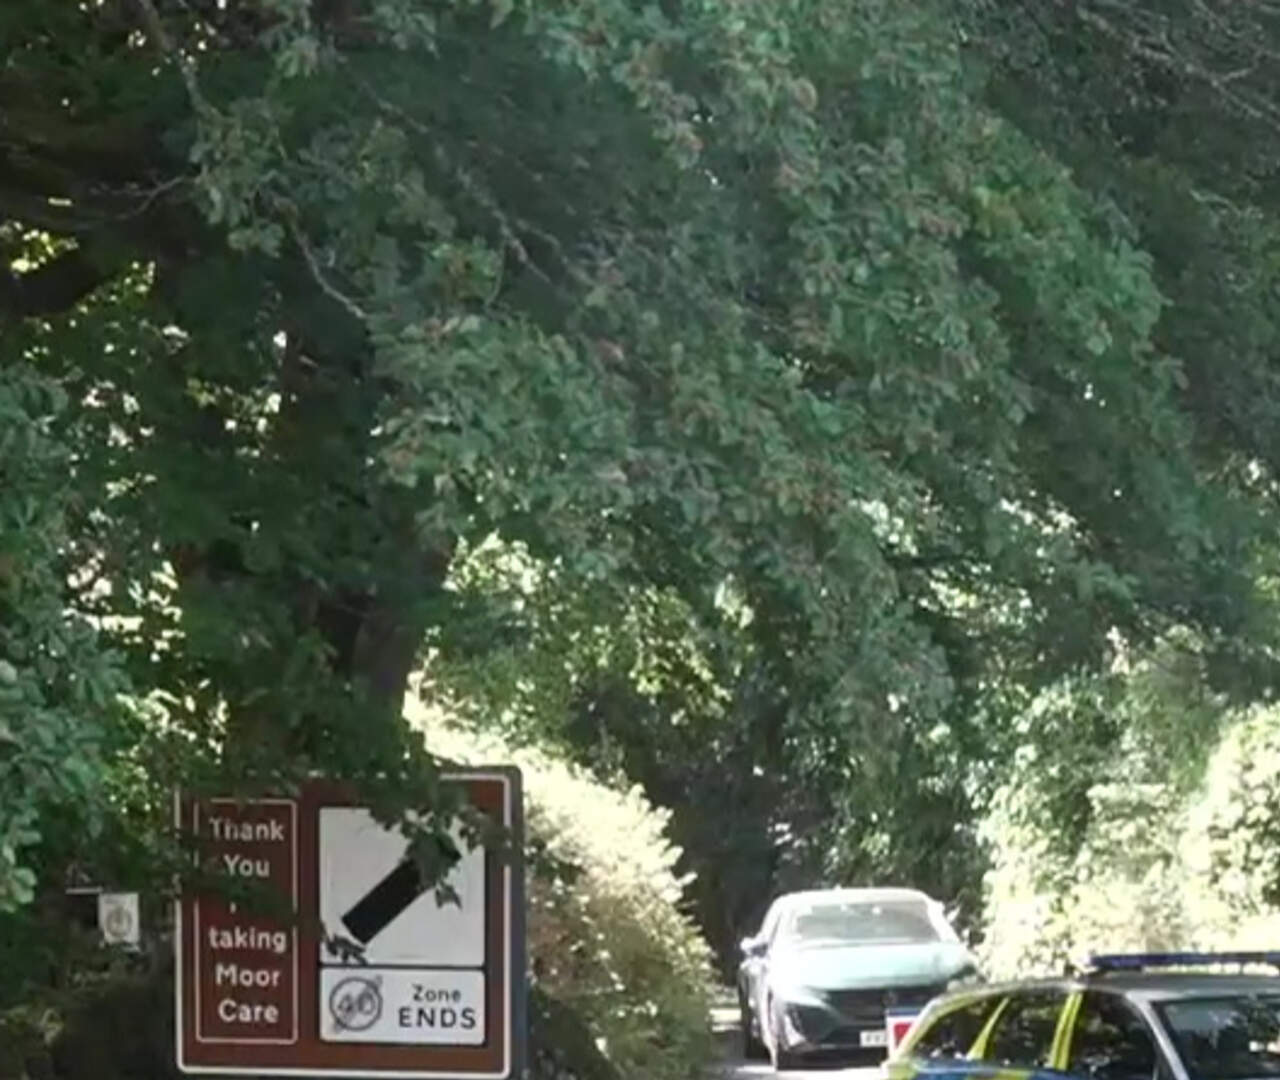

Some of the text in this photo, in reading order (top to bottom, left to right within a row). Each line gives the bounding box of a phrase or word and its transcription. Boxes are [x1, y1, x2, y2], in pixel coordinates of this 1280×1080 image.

[208, 817, 285, 841] Thank
[223, 853, 270, 877] You
[208, 926, 287, 954] taking
[215, 963, 281, 988] Moor
[411, 983, 462, 1002] Zone
[217, 998, 280, 1024] Care
[398, 1006, 477, 1030] ENDS
